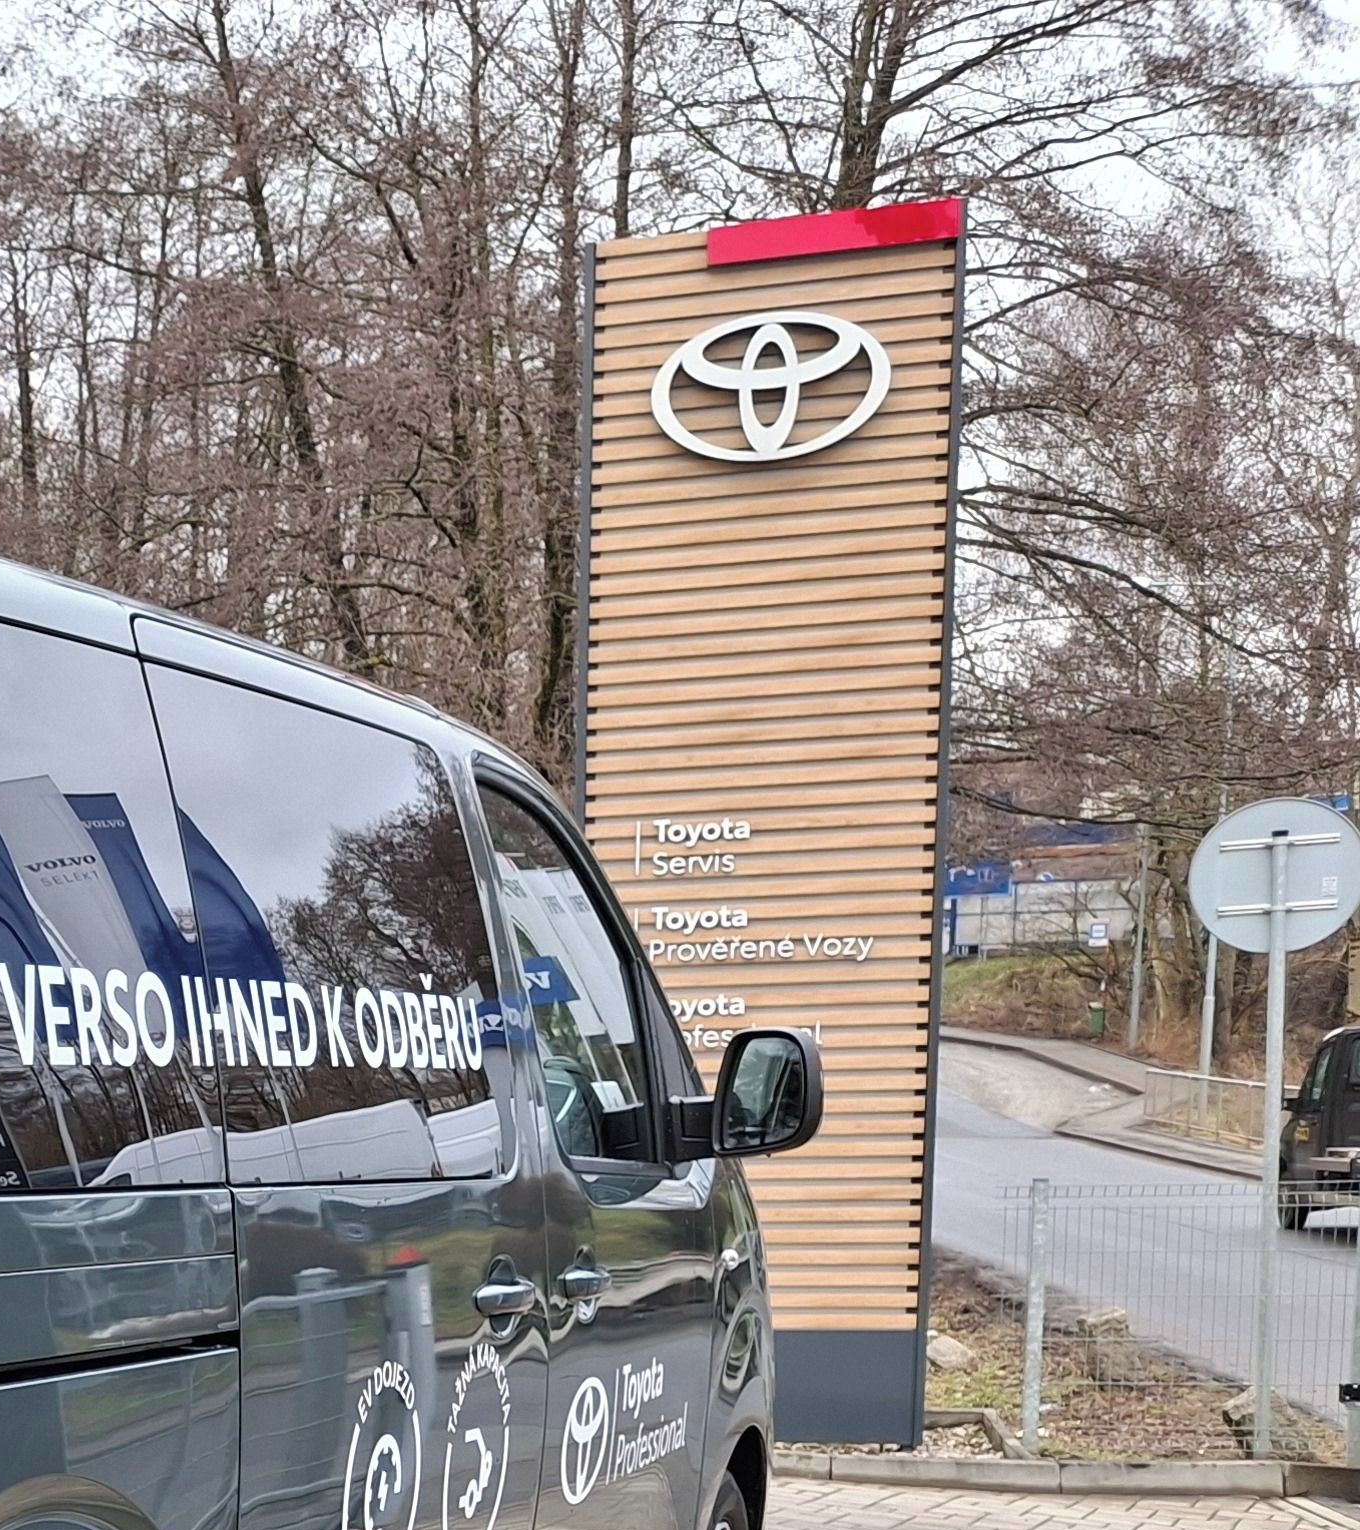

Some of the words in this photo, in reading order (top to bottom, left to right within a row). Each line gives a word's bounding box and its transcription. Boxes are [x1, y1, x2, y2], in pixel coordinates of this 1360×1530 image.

[80, 818, 126, 830] VOLVO
[653, 817, 752, 848] Toyota
[24, 854, 97, 874] VOLVO
[652, 848, 736, 877] Servis
[41, 869, 101, 888] SELEKT
[650, 905, 749, 935] Toyota
[648, 935, 796, 963] Prověřené
[802, 932, 875, 962] Vozy
[180, 974, 318, 1069] IHNED
[320, 982, 355, 1070] K
[356, 971, 483, 1071] ODBĚRU
[669, 993, 746, 1023] oyota
[358, 1378, 373, 1425] EV
[372, 1360, 416, 1411] DOJEZD
[447, 1345, 476, 1434] TAŽNÁ
[476, 1342, 511, 1425] KAPACITA
[622, 1356, 664, 1420] Toyota
[613, 1401, 689, 1482] Professional
